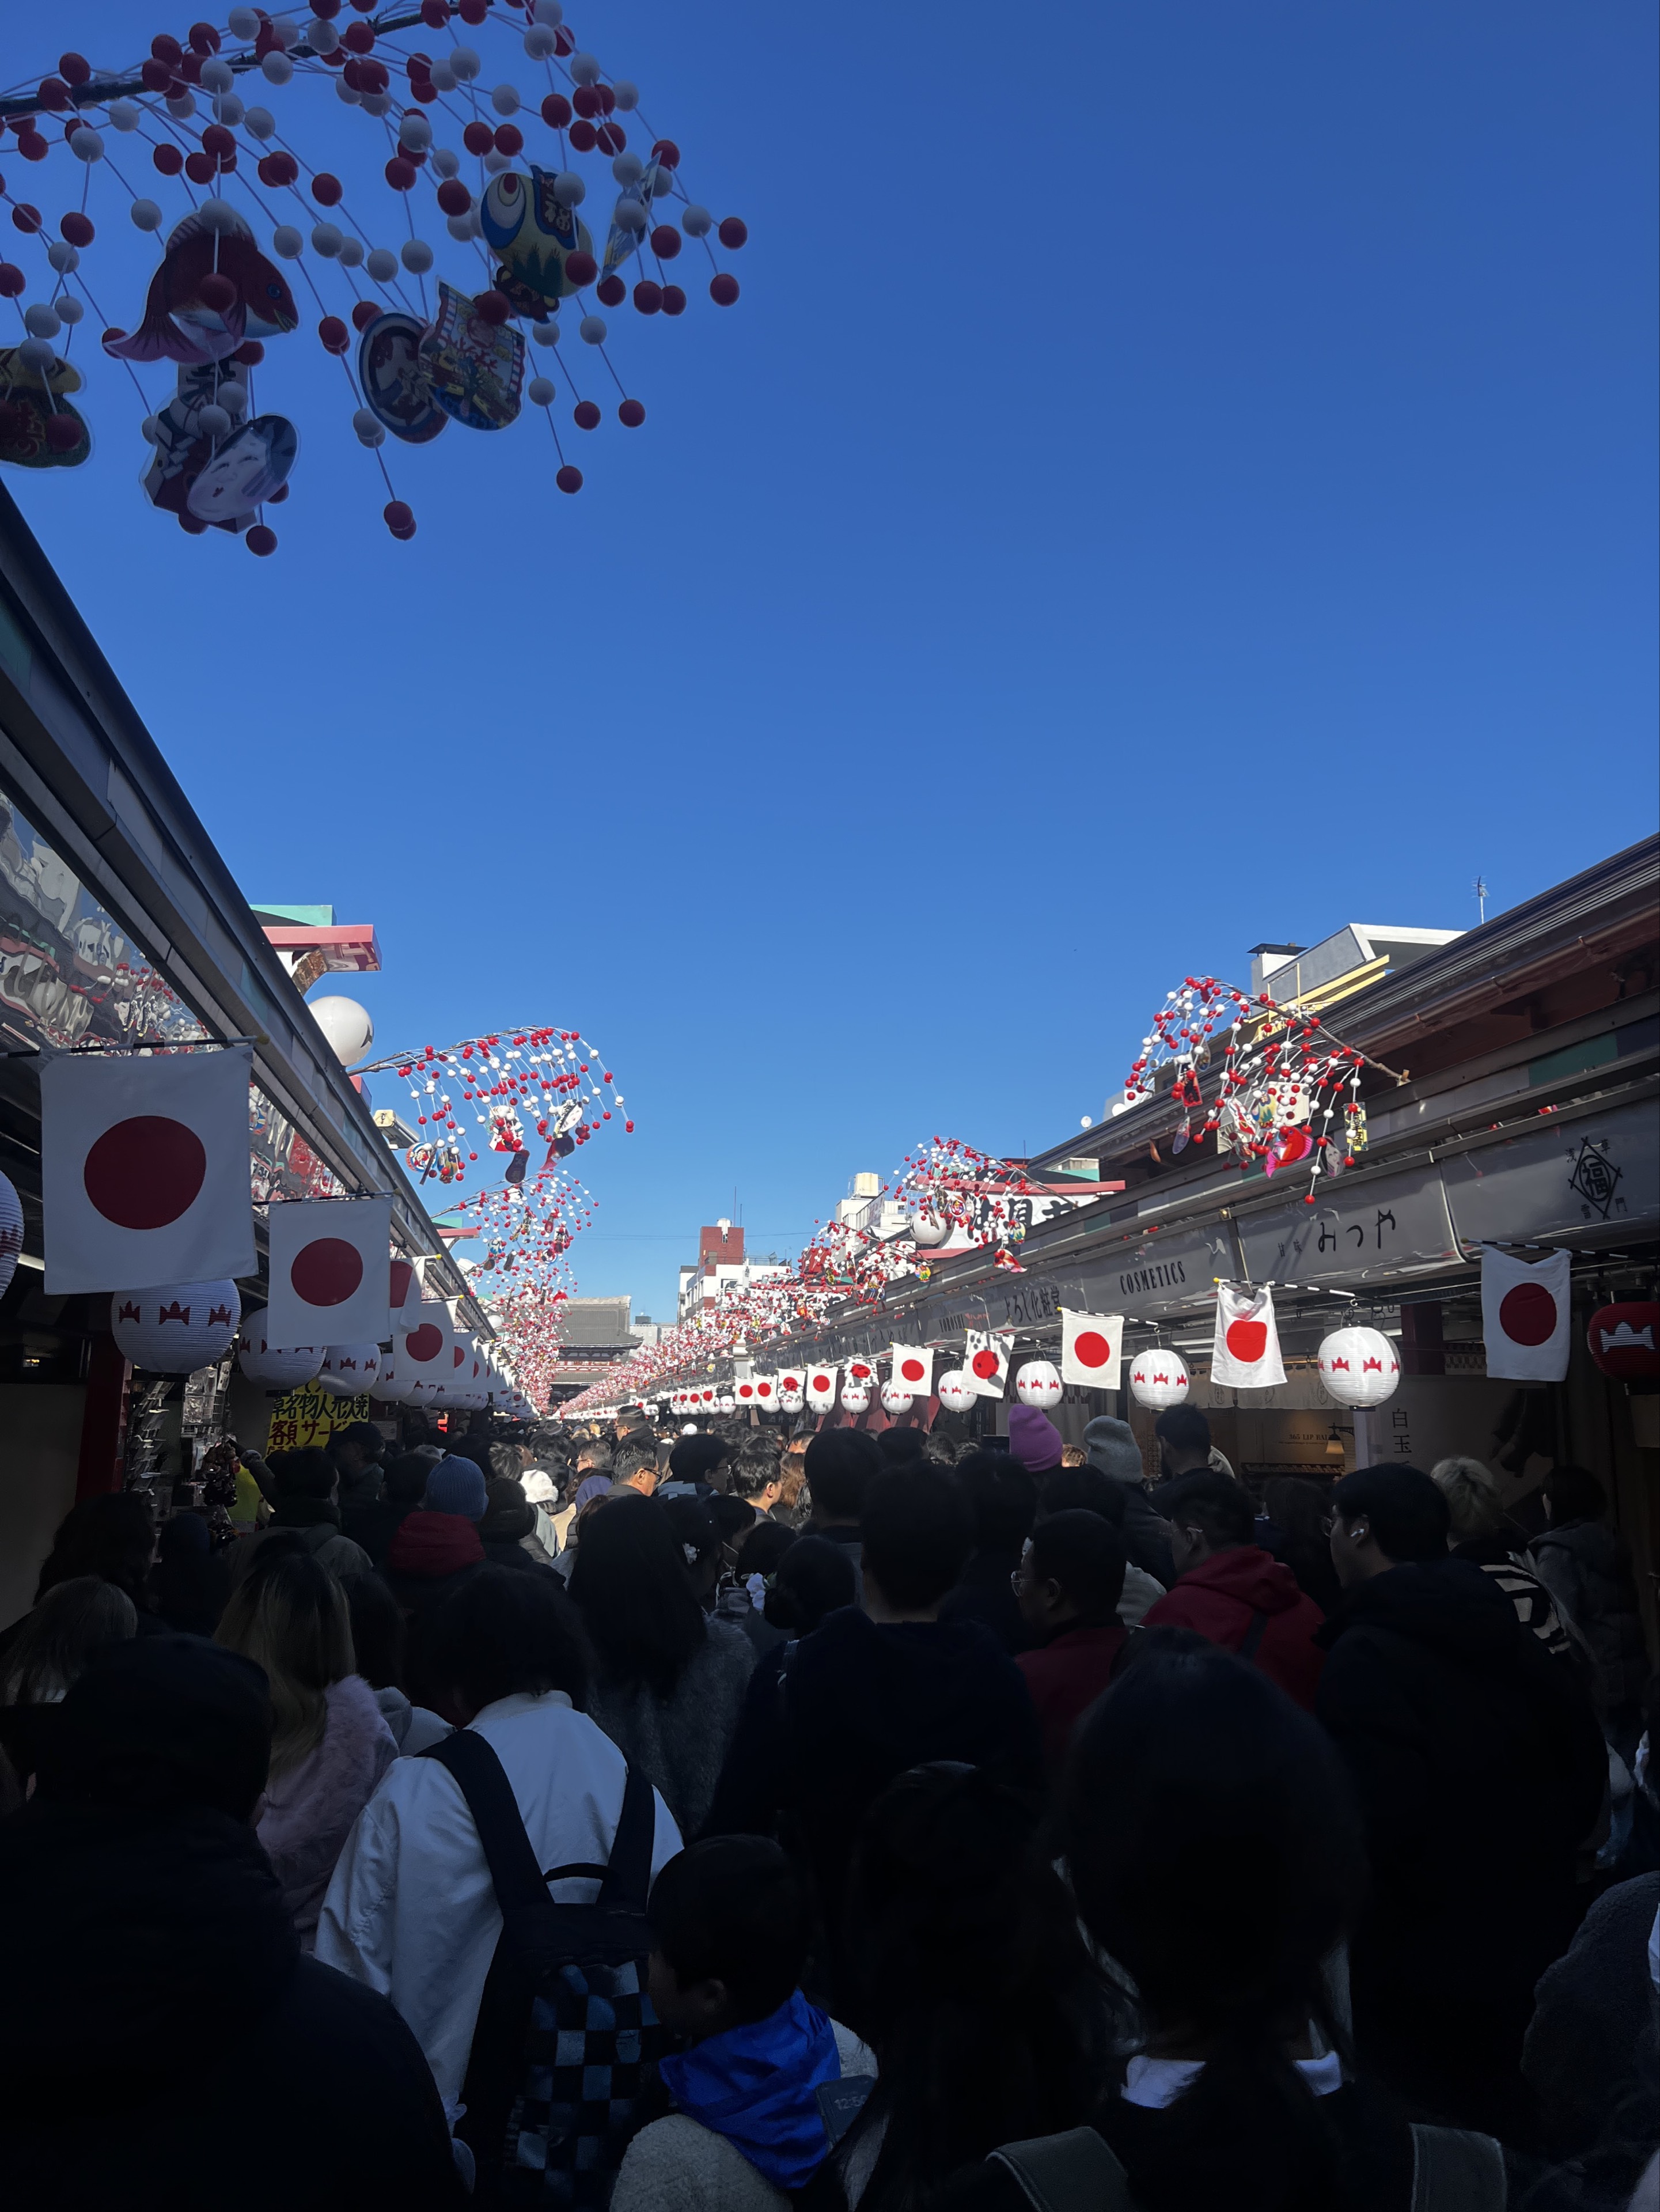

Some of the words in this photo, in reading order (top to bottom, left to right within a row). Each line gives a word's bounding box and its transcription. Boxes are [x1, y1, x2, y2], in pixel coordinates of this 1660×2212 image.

[1582, 1161, 1609, 1198] 福
[1278, 1238, 1303, 1258] 甘味
[1317, 1209, 1396, 1253] みつや
[1120, 1260, 1186, 1296] COSMETICS
[938, 1313, 965, 1333] YOROSHI
[1392, 1407, 1412, 1464] 白玉
